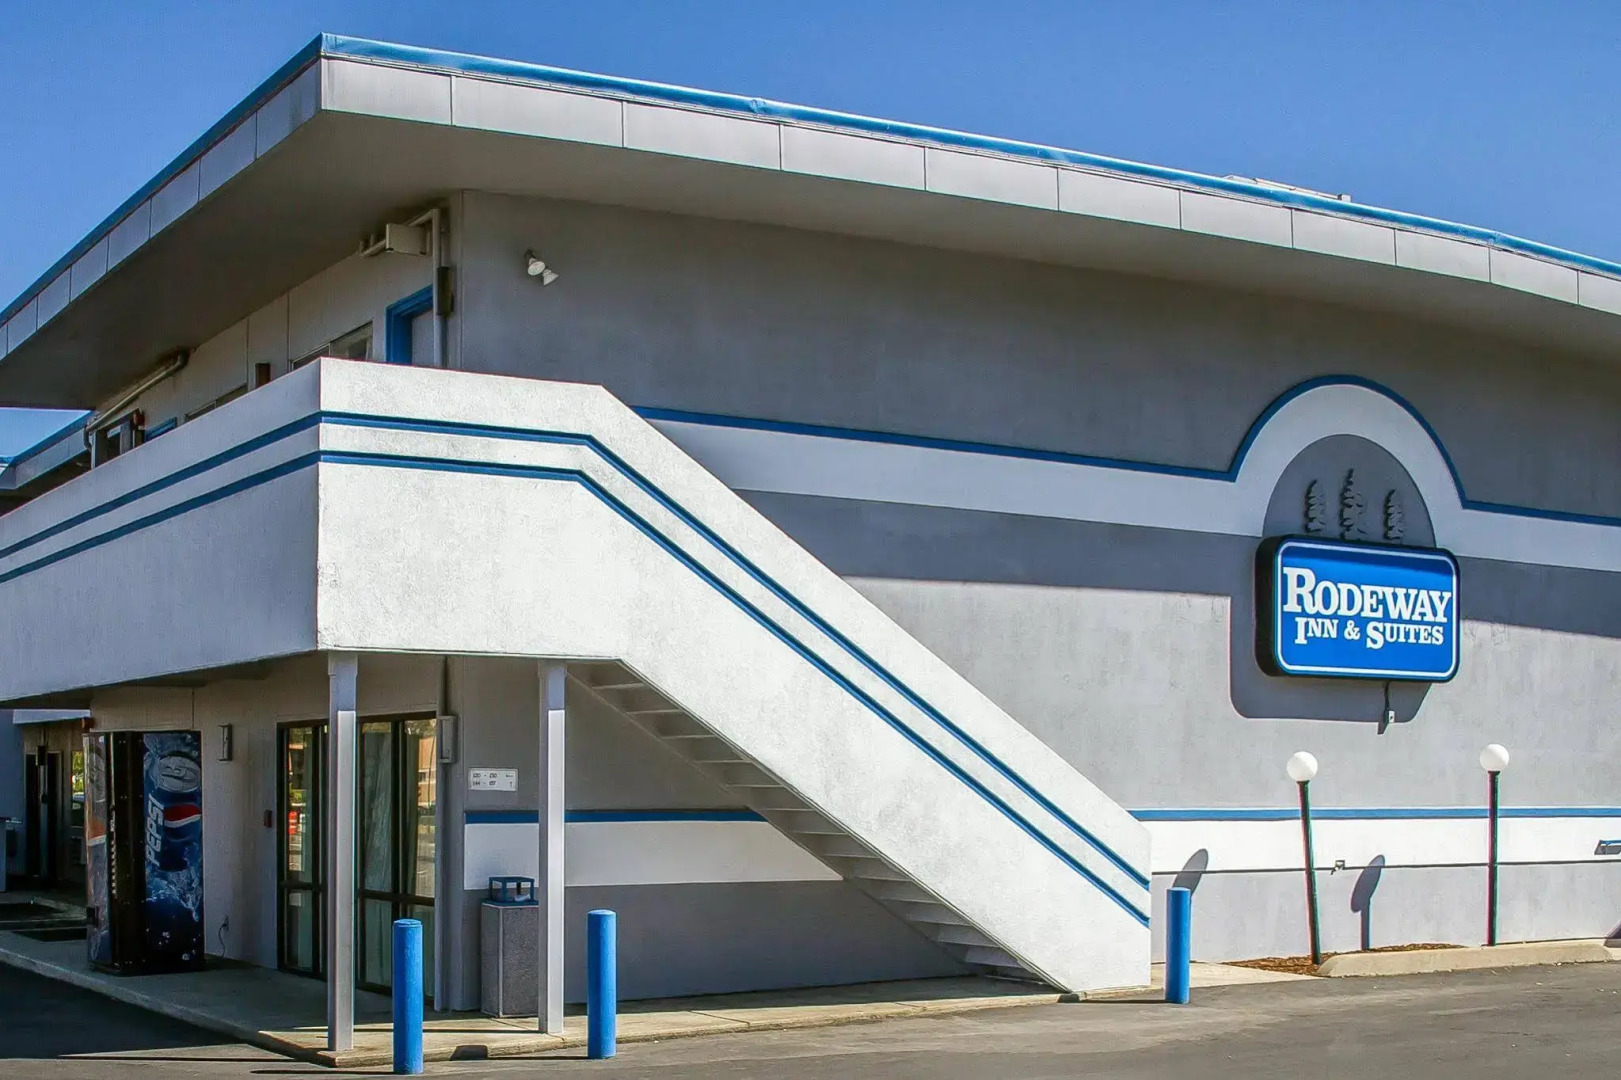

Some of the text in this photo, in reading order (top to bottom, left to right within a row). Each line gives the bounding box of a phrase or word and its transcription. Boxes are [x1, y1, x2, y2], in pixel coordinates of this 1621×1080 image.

[1283, 567, 1451, 623] RODEWAY
[1295, 617, 1444, 649] INN & SUITES
[146, 793, 165, 867] PEPSI
